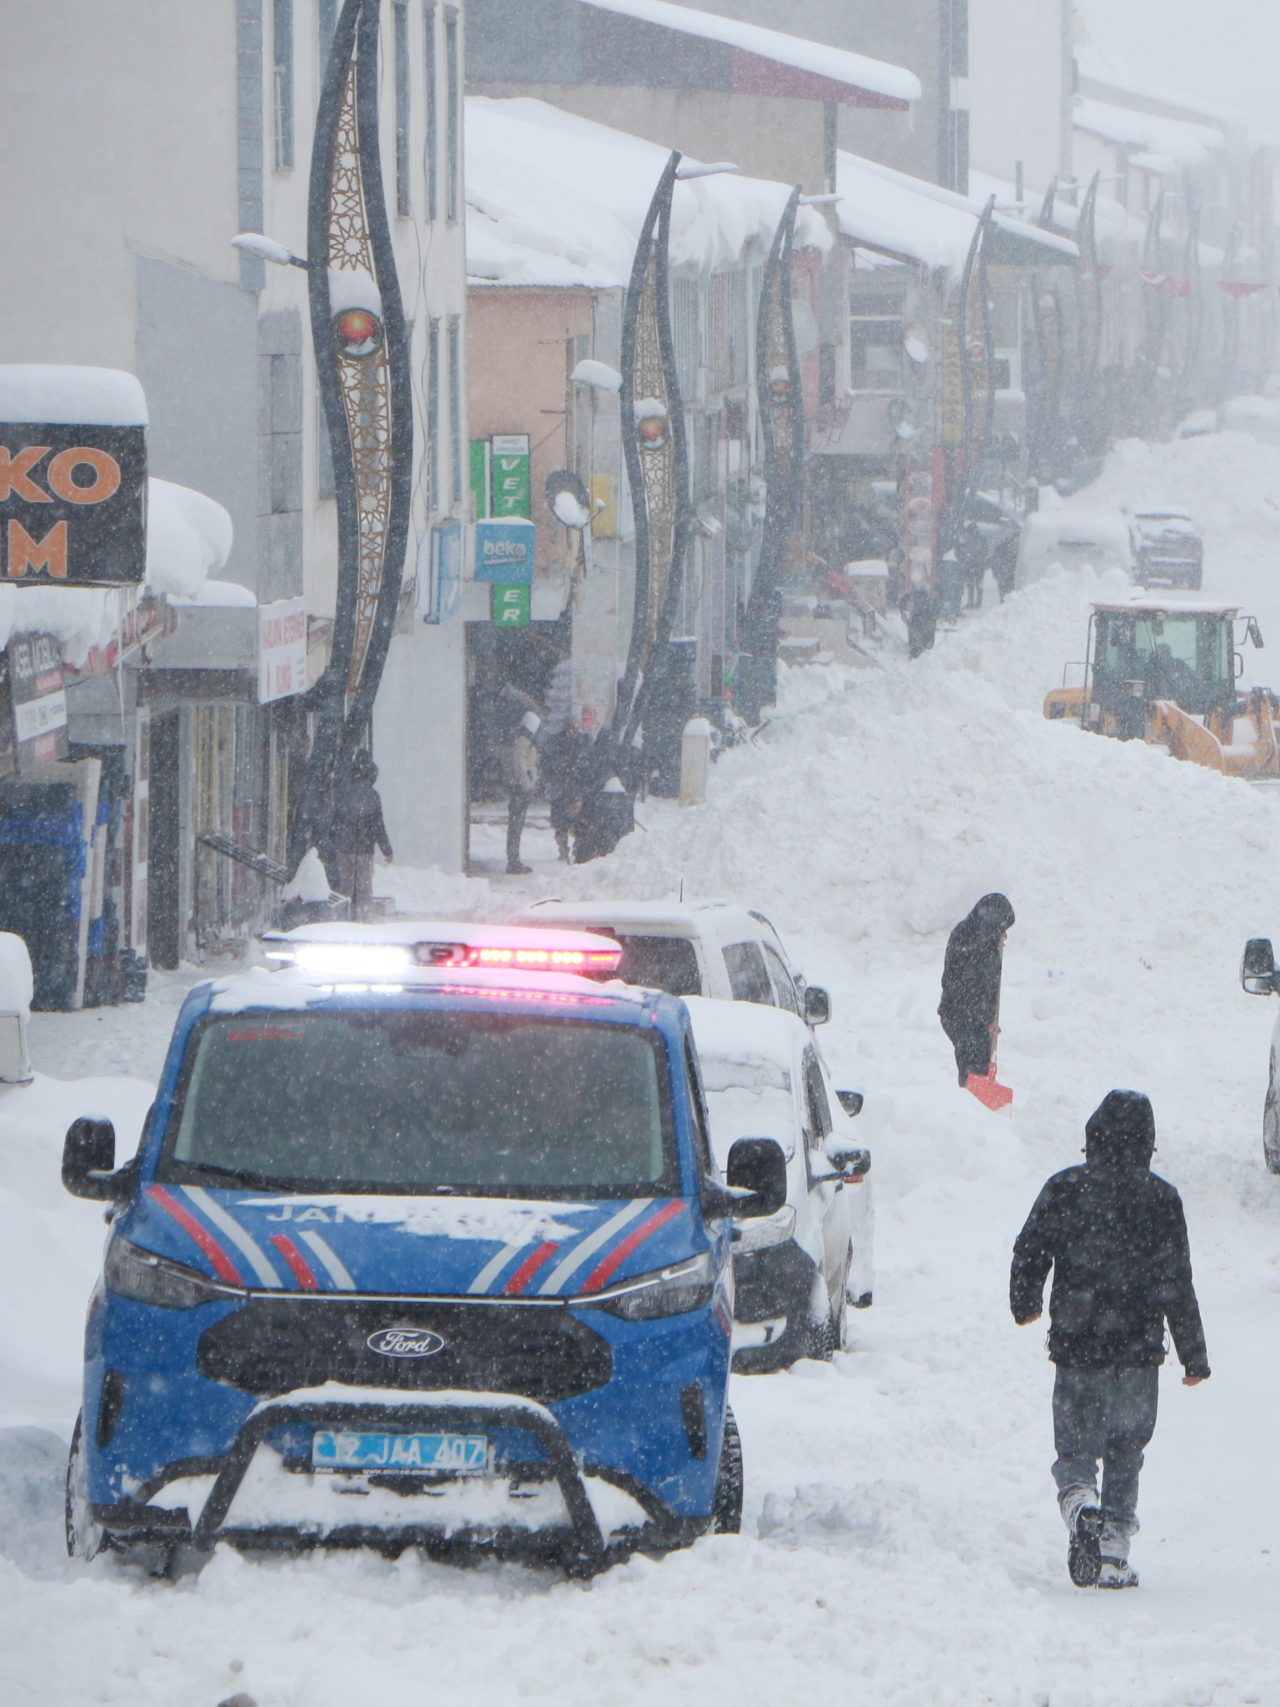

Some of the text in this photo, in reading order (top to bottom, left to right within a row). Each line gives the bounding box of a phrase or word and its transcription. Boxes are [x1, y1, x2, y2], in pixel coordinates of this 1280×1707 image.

[483, 539, 526, 556] beko
[380, 1331, 431, 1353] Ford
[373, 1438, 422, 1465] JAA
